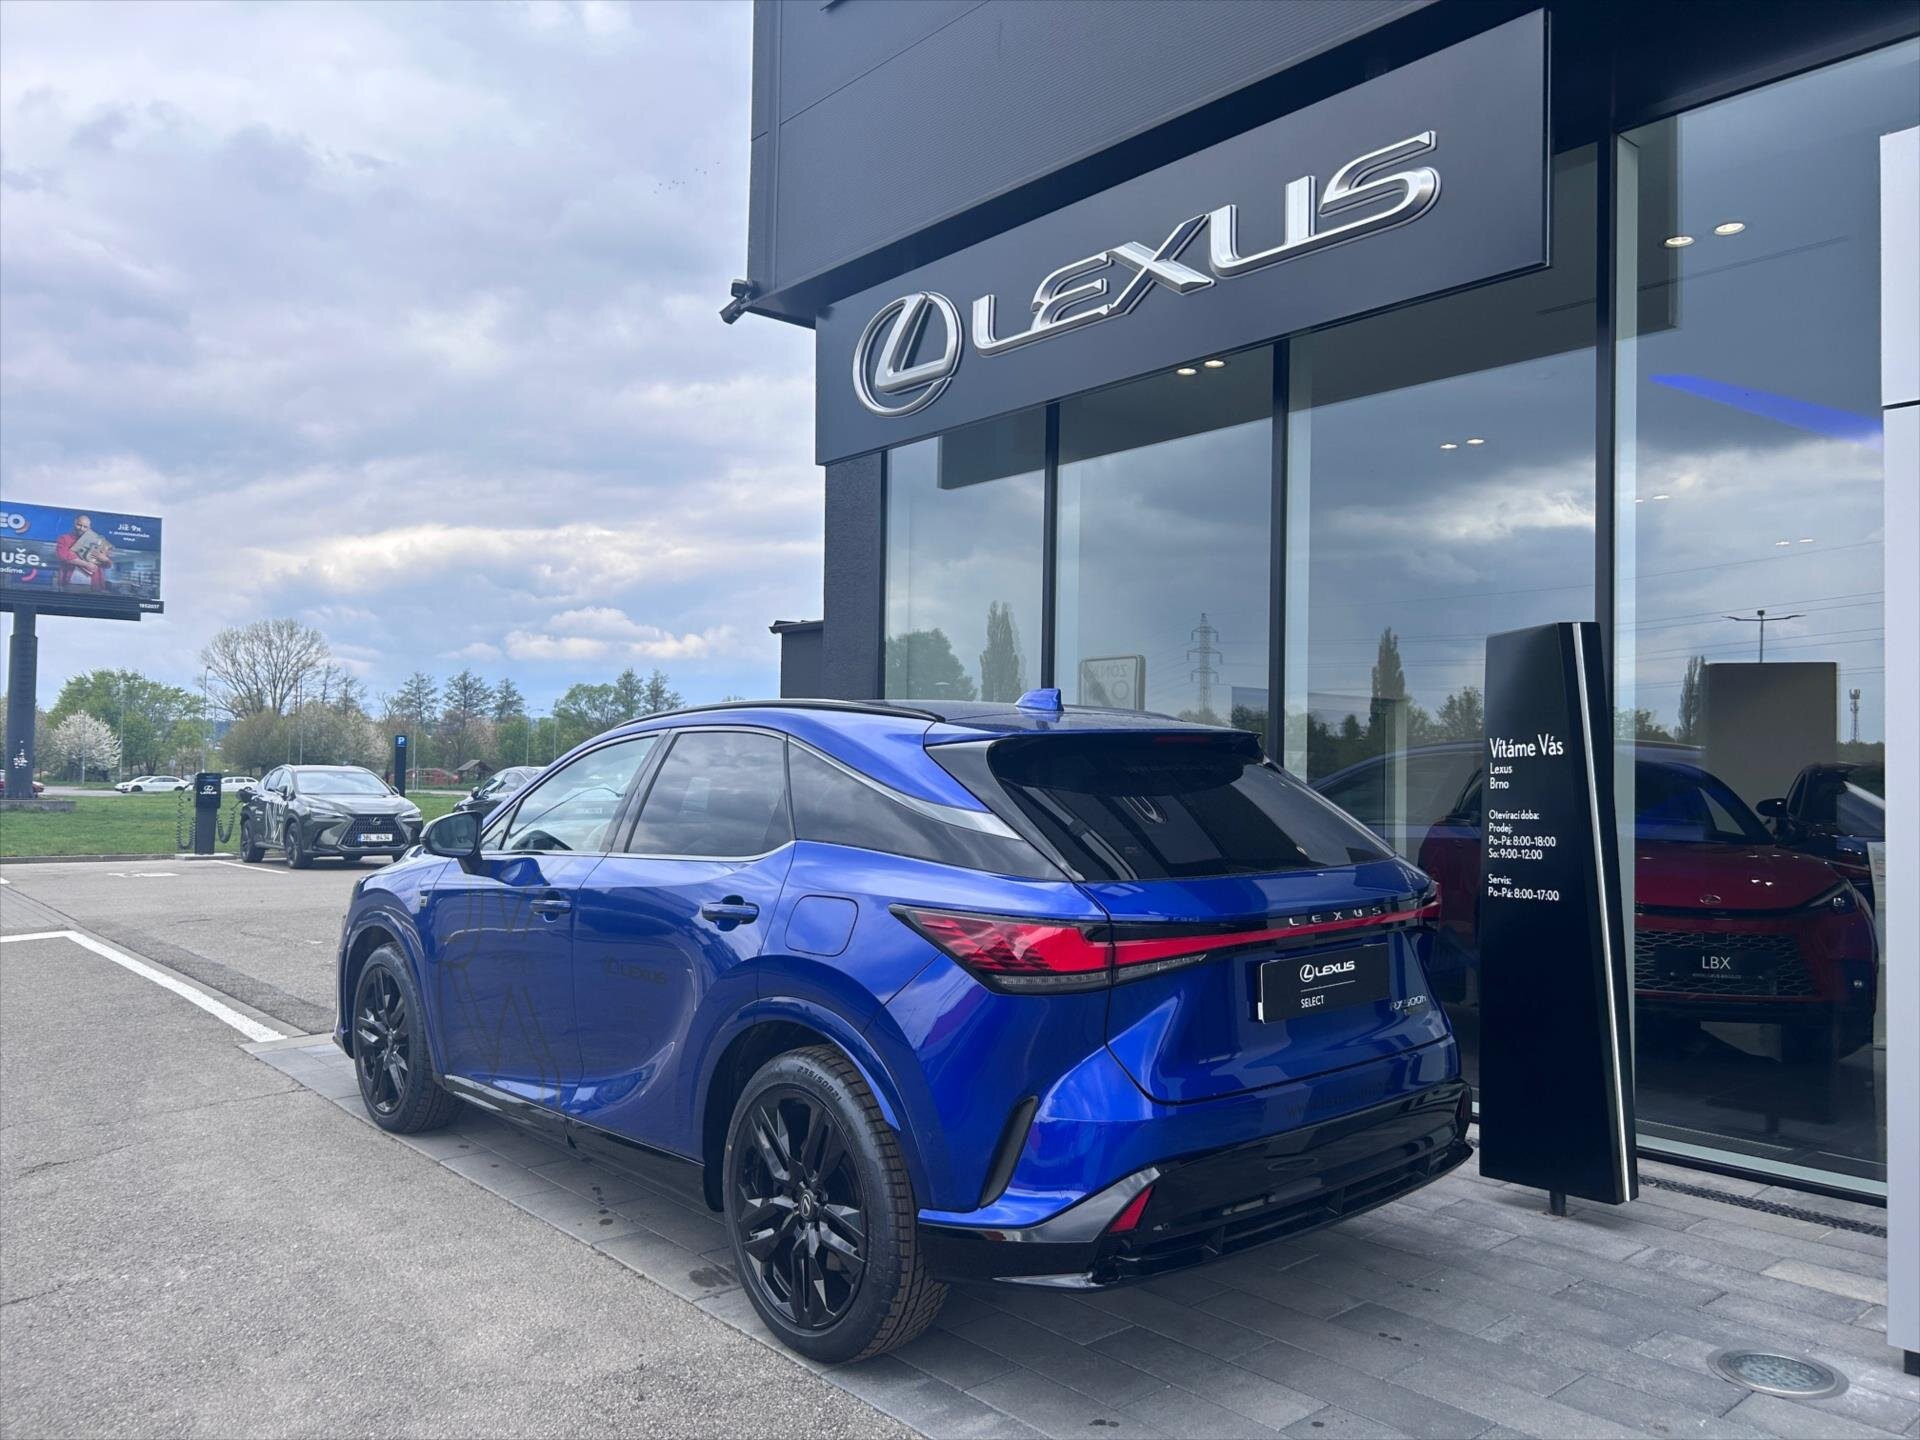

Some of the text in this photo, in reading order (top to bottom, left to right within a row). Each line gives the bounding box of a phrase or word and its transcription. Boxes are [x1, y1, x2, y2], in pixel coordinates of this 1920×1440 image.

[971, 130, 1442, 357] LEXUS
[1489, 733, 1564, 759] Vítáme Vás
[1489, 762, 1513, 775] Lexus
[1489, 776, 1510, 790] Brno
[1288, 906, 1382, 926] LEXUS
[1315, 960, 1355, 977] LEXUS
[1701, 955, 1731, 970] LBX
[1300, 994, 1325, 1009] SELECT
